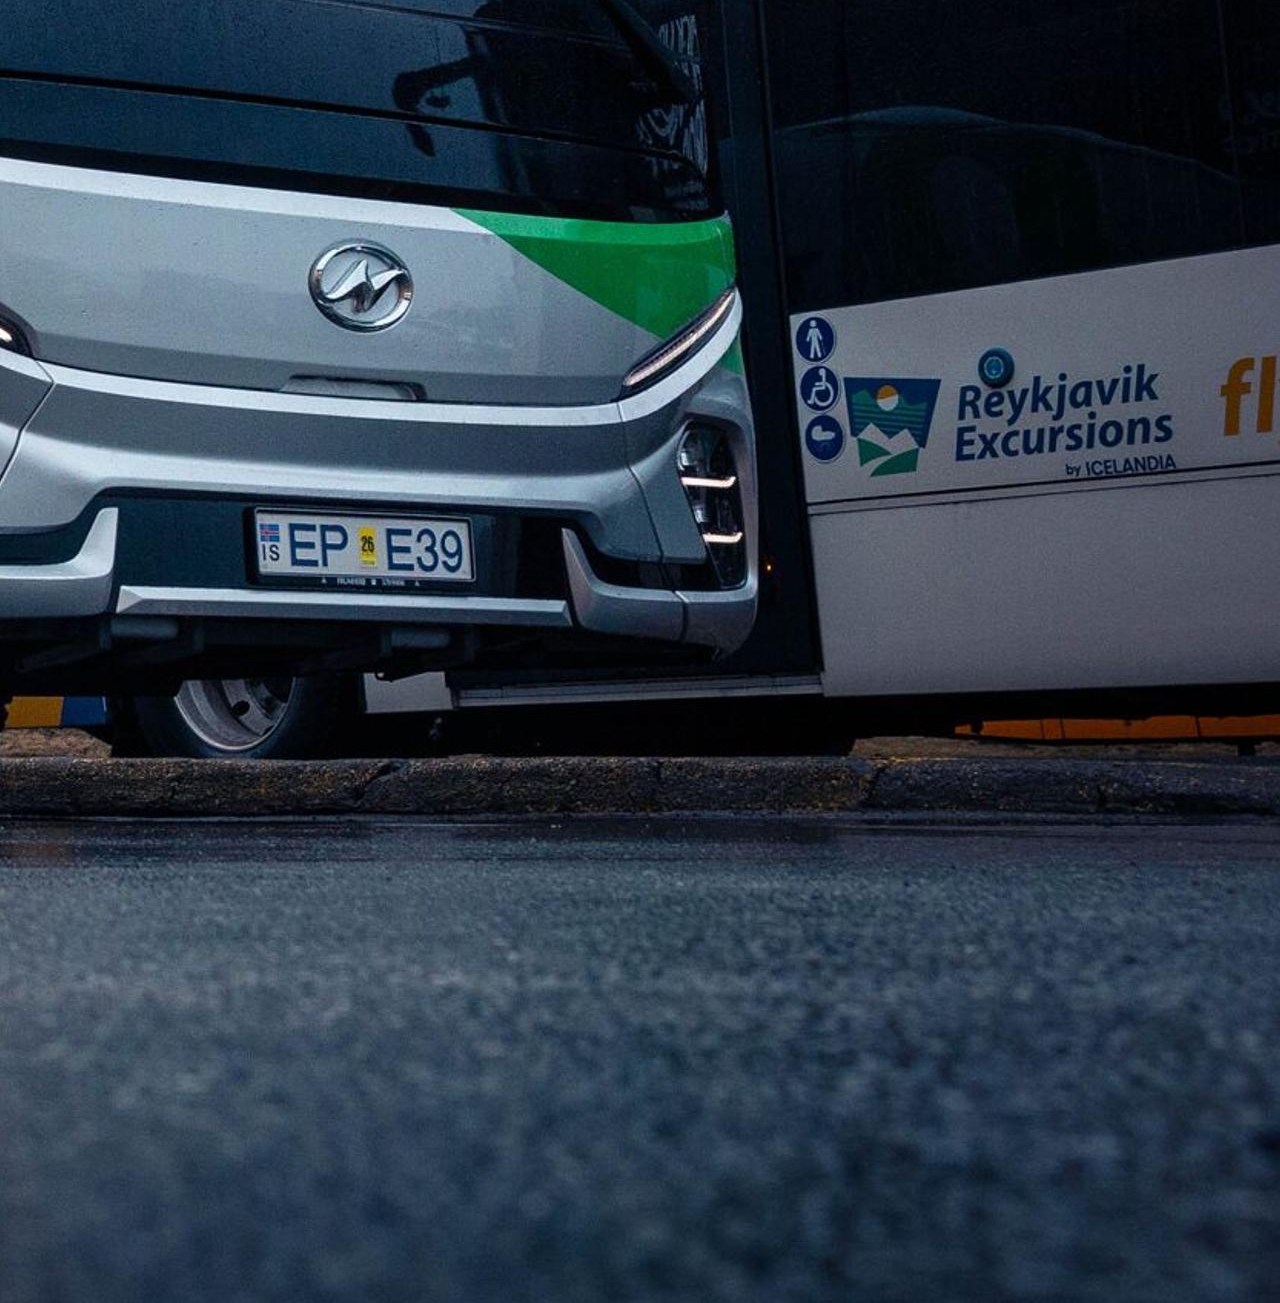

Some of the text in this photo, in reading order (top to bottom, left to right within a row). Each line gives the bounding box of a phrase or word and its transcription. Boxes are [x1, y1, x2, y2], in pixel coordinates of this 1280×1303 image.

[957, 355, 1280, 440] Reykjavik fl
[955, 410, 1174, 462] Excursions
[1065, 453, 1177, 477] by ICELANDIA
[261, 522, 463, 574] IS EP 26 E39
